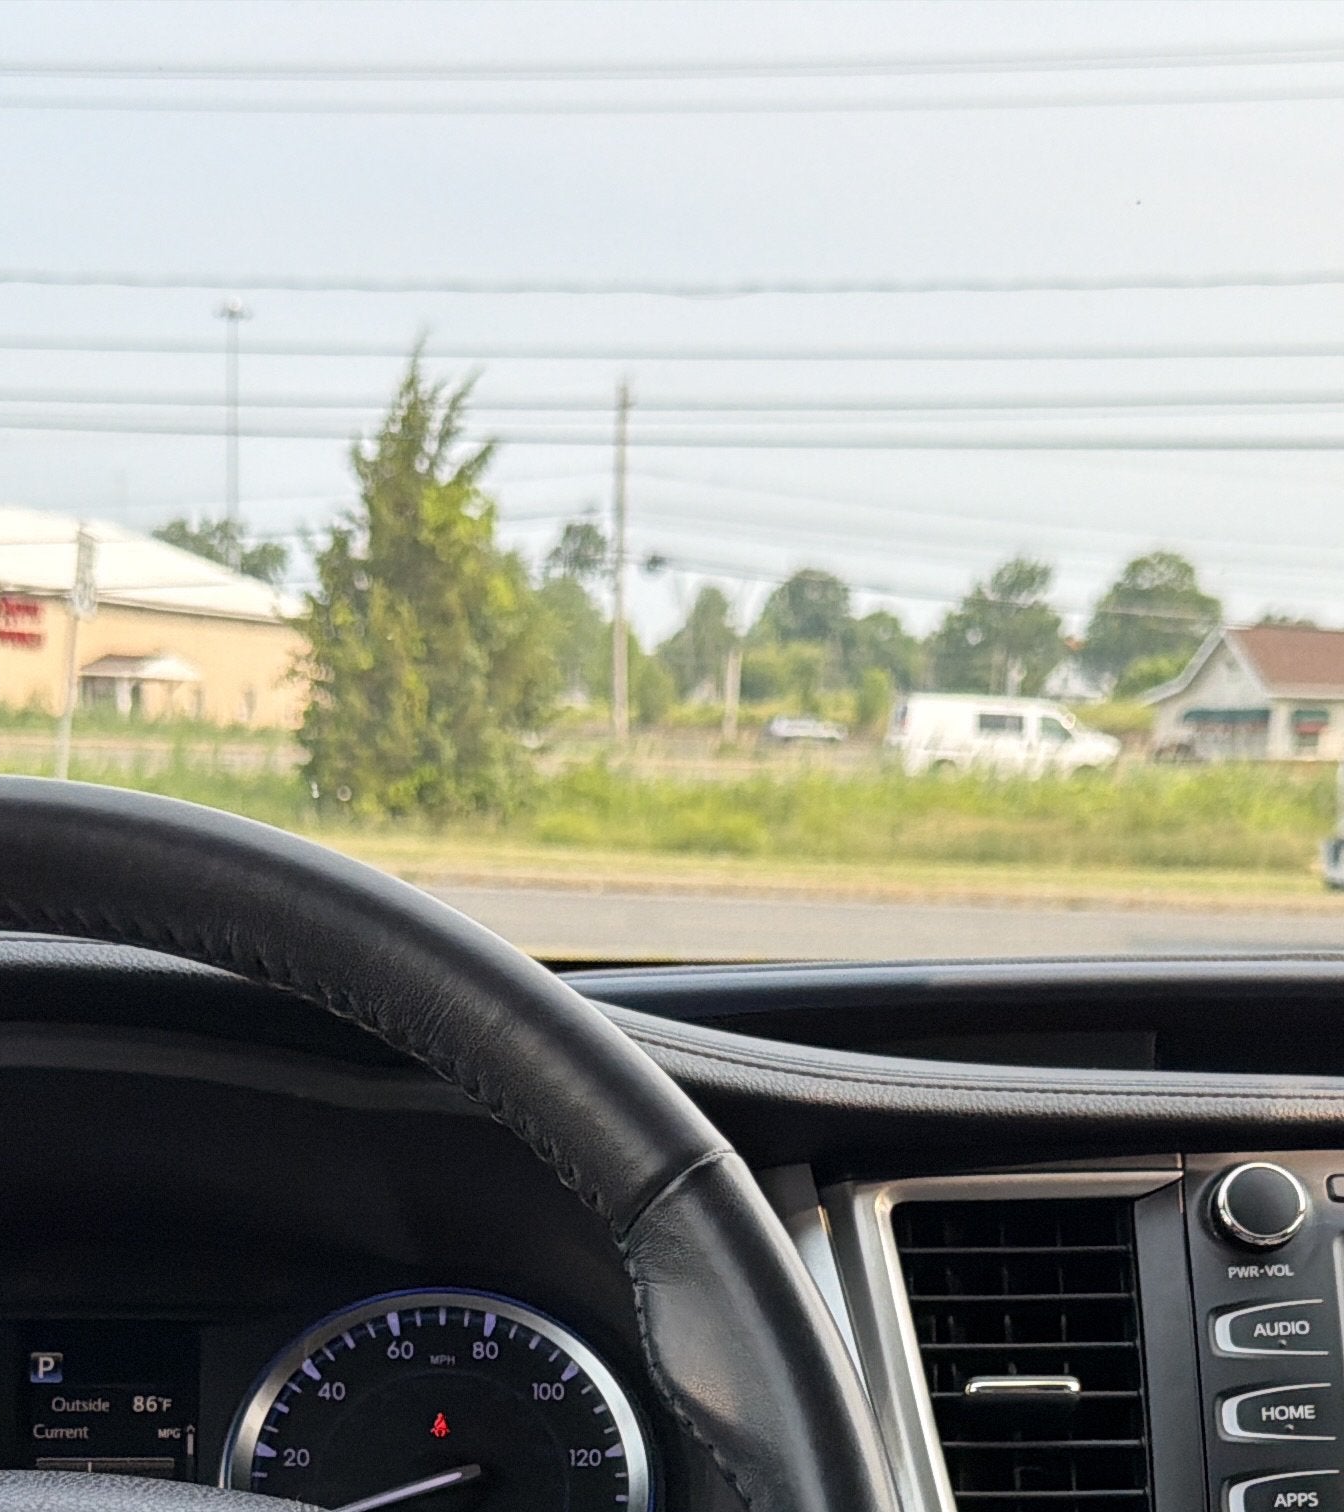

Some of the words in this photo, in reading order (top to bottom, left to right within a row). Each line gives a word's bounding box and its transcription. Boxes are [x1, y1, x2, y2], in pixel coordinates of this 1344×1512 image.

[1253, 1320, 1310, 1337] AUDIO
[386, 1341, 414, 1360] 60
[429, 1354, 456, 1365] MPH
[472, 1341, 499, 1360] 80
[37, 1358, 55, 1377] P
[318, 1382, 346, 1401] 40
[532, 1382, 565, 1401] 100
[52, 1397, 110, 1413] Outside
[1261, 1405, 1316, 1421] HOME
[33, 1424, 89, 1440] Current
[157, 1428, 181, 1440] MPG
[283, 1449, 310, 1467] 20
[569, 1449, 602, 1467] 120
[1274, 1492, 1319, 1508] APPS
